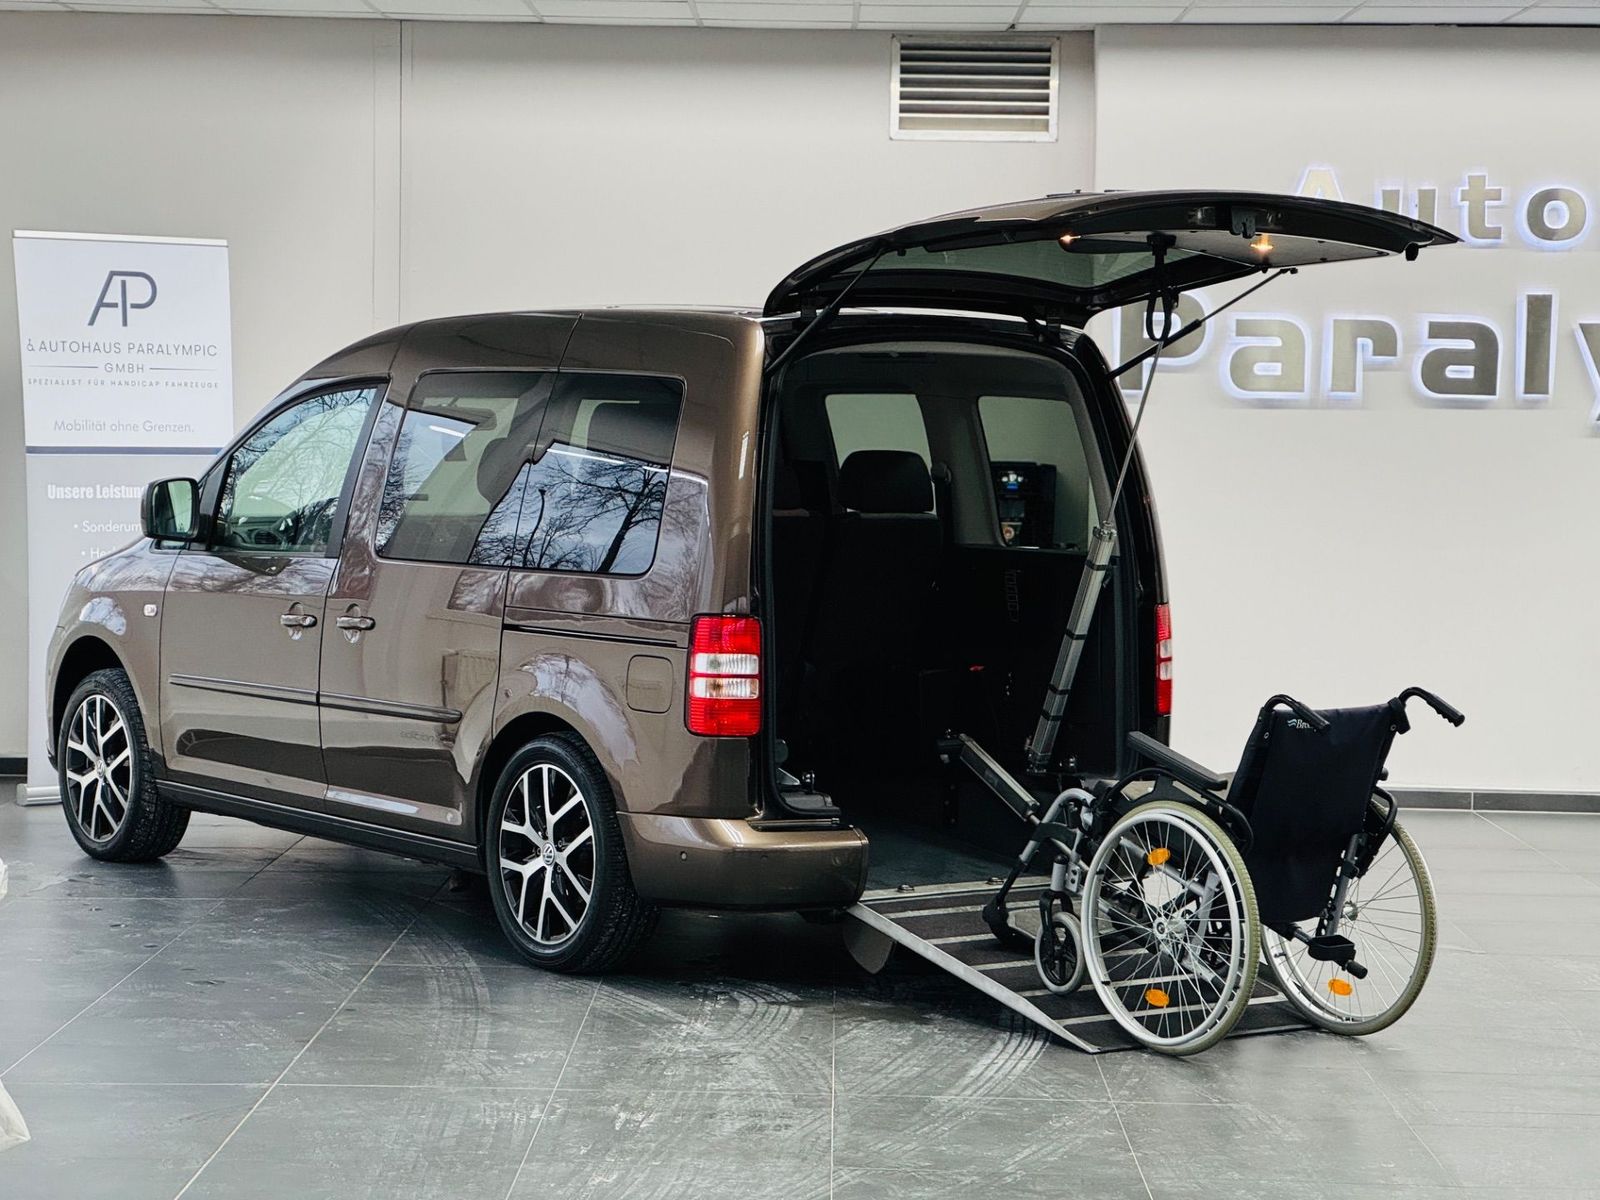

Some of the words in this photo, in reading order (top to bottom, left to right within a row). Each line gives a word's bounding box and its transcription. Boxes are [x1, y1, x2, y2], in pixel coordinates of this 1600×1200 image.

[38, 340, 122, 354] AUTOHAUS
[128, 343, 218, 356] PARALYMPIC
[104, 363, 145, 374] GMBH
[28, 378, 82, 386] SPEZIALIST
[110, 380, 160, 388] HANDICAP
[165, 381, 219, 389] FAHRZEUGE
[53, 419, 106, 432] Mobilität
[110, 420, 139, 432] ohne
[143, 420, 195, 433] Grenzen.
[47, 484, 93, 499] Unsere
